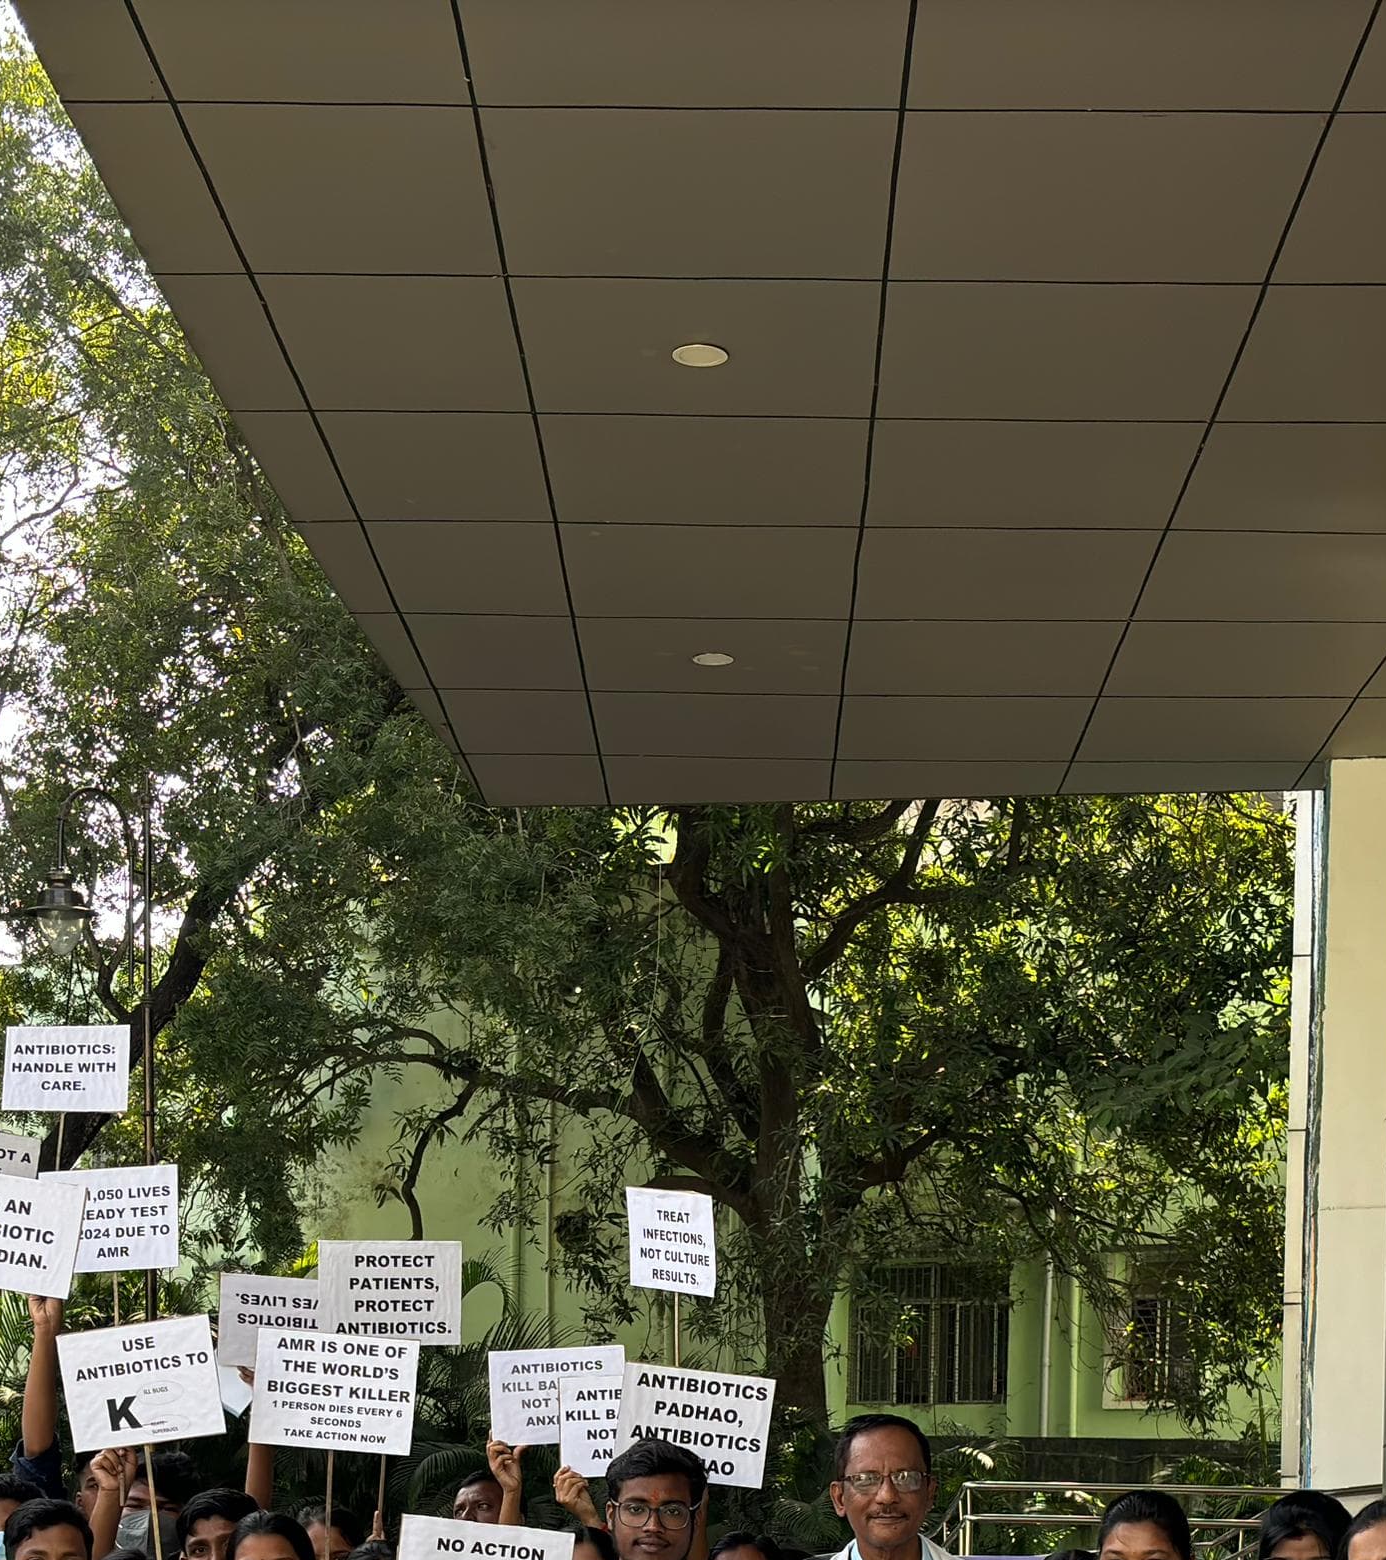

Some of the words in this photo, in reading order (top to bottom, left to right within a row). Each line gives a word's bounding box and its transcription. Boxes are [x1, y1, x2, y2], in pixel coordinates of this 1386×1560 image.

[14, 1044, 115, 1054] ANTIBIOTICS:
[12, 1063, 73, 1072] HANDLE
[78, 1062, 115, 1072] WITH
[41, 1081, 85, 1090] CARE.
[21, 1153, 31, 1163] A
[129, 1186, 170, 1198] LIVES
[4, 1200, 31, 1215] AN
[83, 1208, 125, 1220] EADY
[130, 1205, 168, 1217] TEST
[657, 1210, 689, 1223] TREAT
[116, 1226, 145, 1237] DUE
[150, 1225, 170, 1235] TO
[643, 1229, 705, 1248] INFECTIONS,
[97, 1247, 129, 1258] AMR
[641, 1247, 661, 1259] NOT
[665, 1250, 709, 1266] CULTURE
[355, 1256, 434, 1267] PROTECT
[652, 1269, 699, 1285] RESULTS.
[350, 1278, 439, 1292] PATIENTS,
[236, 1294, 286, 1307] LIVES.
[355, 1300, 434, 1312] PROTECT
[237, 1313, 318, 1329] TIBIOTICS
[336, 1322, 452, 1335] ANTIBIOTICS.
[122, 1337, 155, 1352] USE
[277, 1338, 315, 1351] AMR
[322, 1341, 337, 1353] IS
[344, 1343, 379, 1356] ONE
[385, 1346, 407, 1358] OF
[77, 1356, 181, 1381] ANTIBIOTICS
[186, 1352, 208, 1365] TO
[283, 1360, 316, 1373] THE
[511, 1361, 602, 1374] ANTIBIOTICS
[268, 1380, 343, 1397] BIGGEST
[349, 1387, 410, 1403] KILLER
[502, 1382, 533, 1392] KILL
[637, 1372, 769, 1401] ANTIBIOTICS
[282, 1401, 325, 1411] PERSON
[329, 1405, 353, 1414] DIES
[357, 1407, 393, 1417] EVERY
[522, 1398, 551, 1408] NOT
[106, 1395, 143, 1432] K
[566, 1410, 600, 1421] KILL
[655, 1401, 742, 1427] PADHAO,
[310, 1417, 361, 1428] SECONDS
[526, 1415, 560, 1426] ANXI
[284, 1428, 312, 1438] TAKE
[316, 1431, 357, 1441] ACTION
[361, 1435, 386, 1443] NOW
[587, 1429, 617, 1440] NOT
[630, 1425, 761, 1453] ANTIBIOTICS
[437, 1538, 464, 1552] NO
[471, 1542, 544, 1560] ACTION
